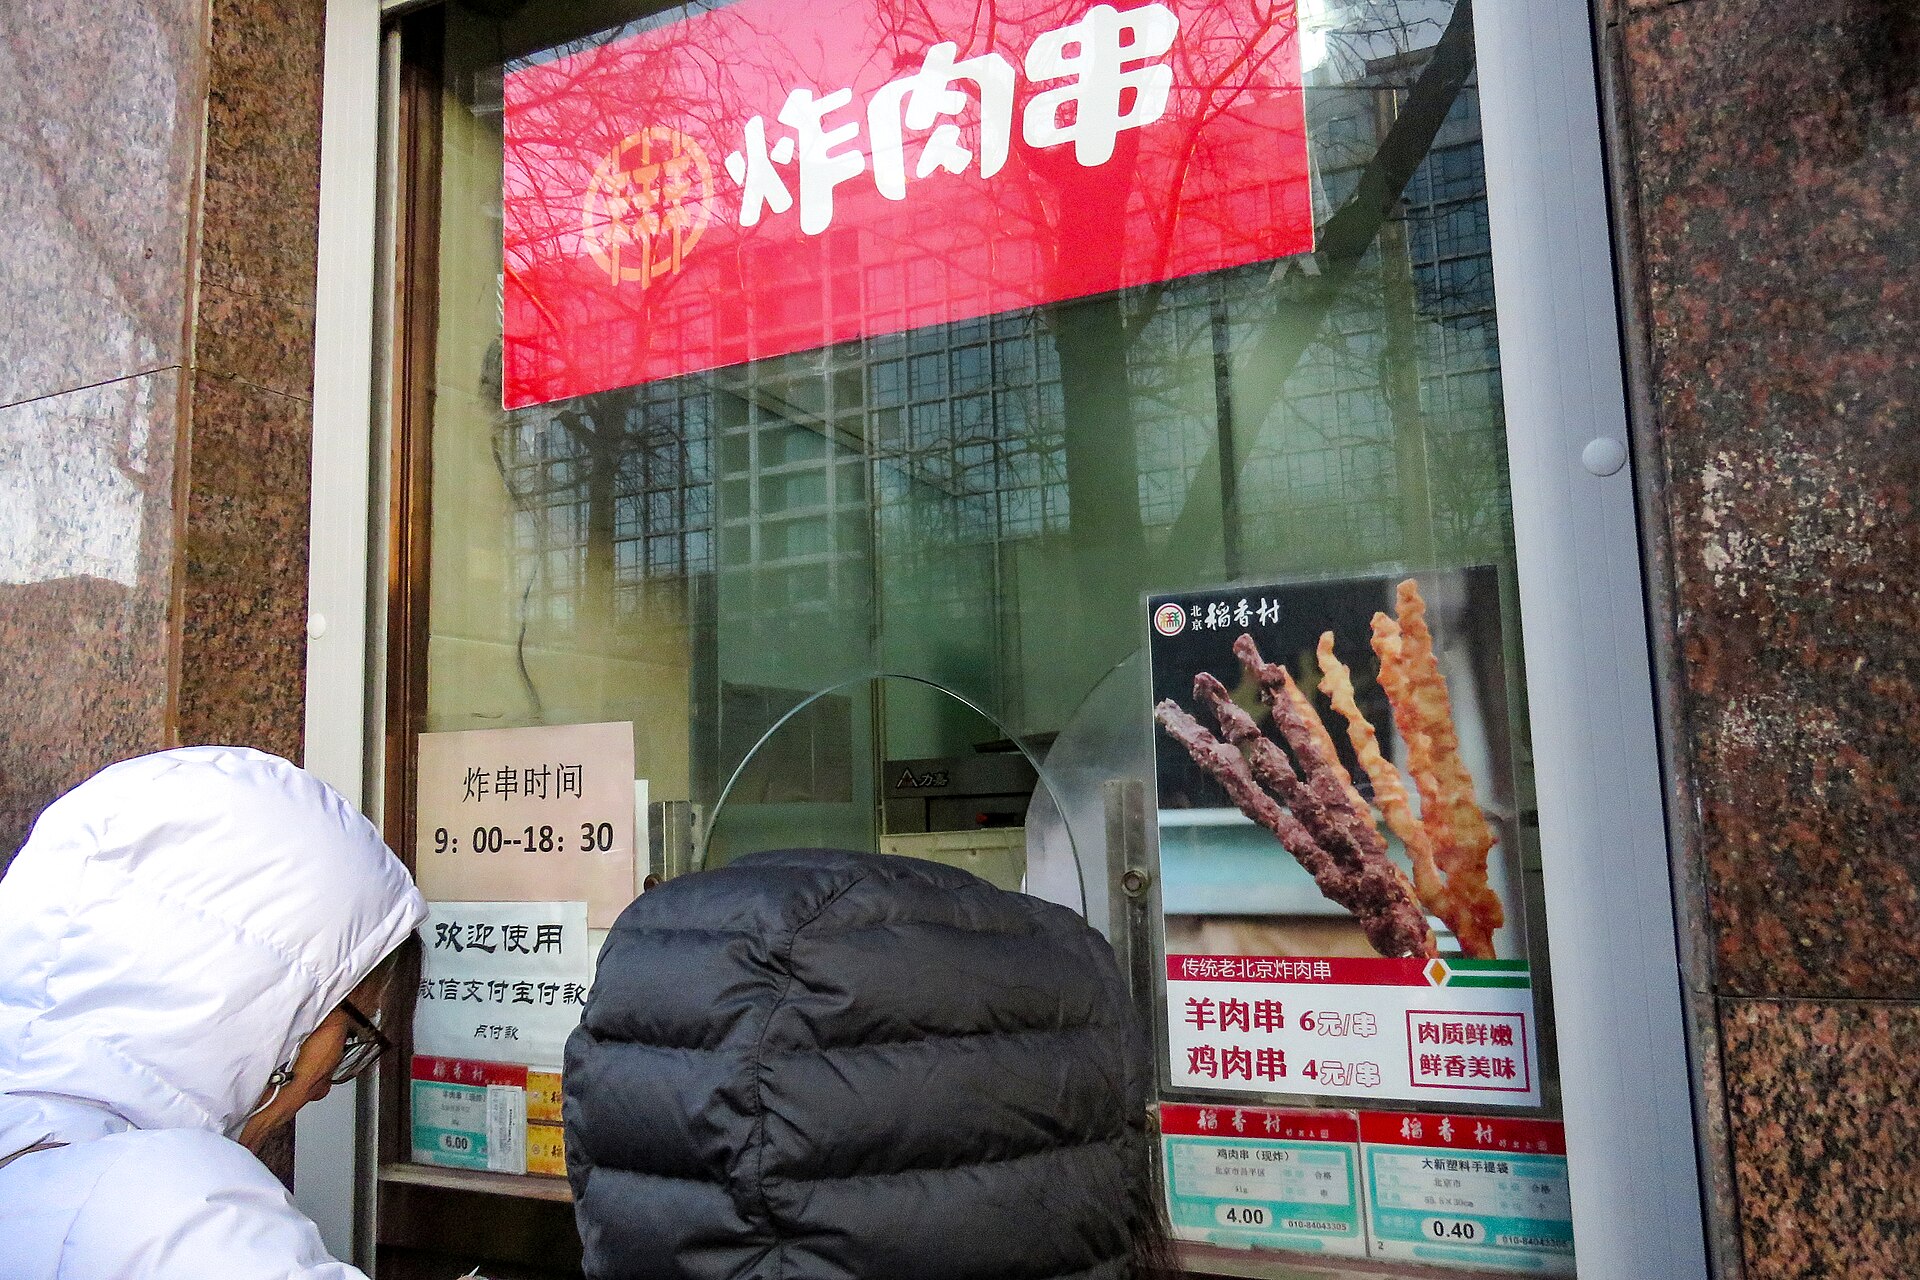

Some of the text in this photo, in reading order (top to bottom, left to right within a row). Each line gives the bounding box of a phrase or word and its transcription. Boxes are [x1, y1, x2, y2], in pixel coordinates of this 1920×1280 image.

[724, 3, 1180, 236] 炸肉串
[1190, 597, 1280, 631] 北京 稻香村
[462, 763, 583, 802] 炸串时间
[434, 921, 564, 955] 欢迎使用
[1181, 957, 1332, 981] 传统老北京炸肉串
[1184, 997, 1286, 1034] 羊肉串
[474, 1024, 520, 1041] 点付款
[1417, 1021, 1514, 1048] 肉质鲜嫩
[1186, 1045, 1288, 1083] 鸡肉串
[1418, 1053, 1517, 1080] 鲜香美味
[1197, 1109, 1280, 1133] 稻香村
[1400, 1116, 1494, 1144] 稻香村
[445, 1135, 468, 1150] 6.00
[1421, 1157, 1510, 1175] 大新塑料手提袋
[1226, 1207, 1265, 1225] 4.00
[1433, 1220, 1475, 1240] 0.40
[1378, 1240, 1385, 1250] 2
